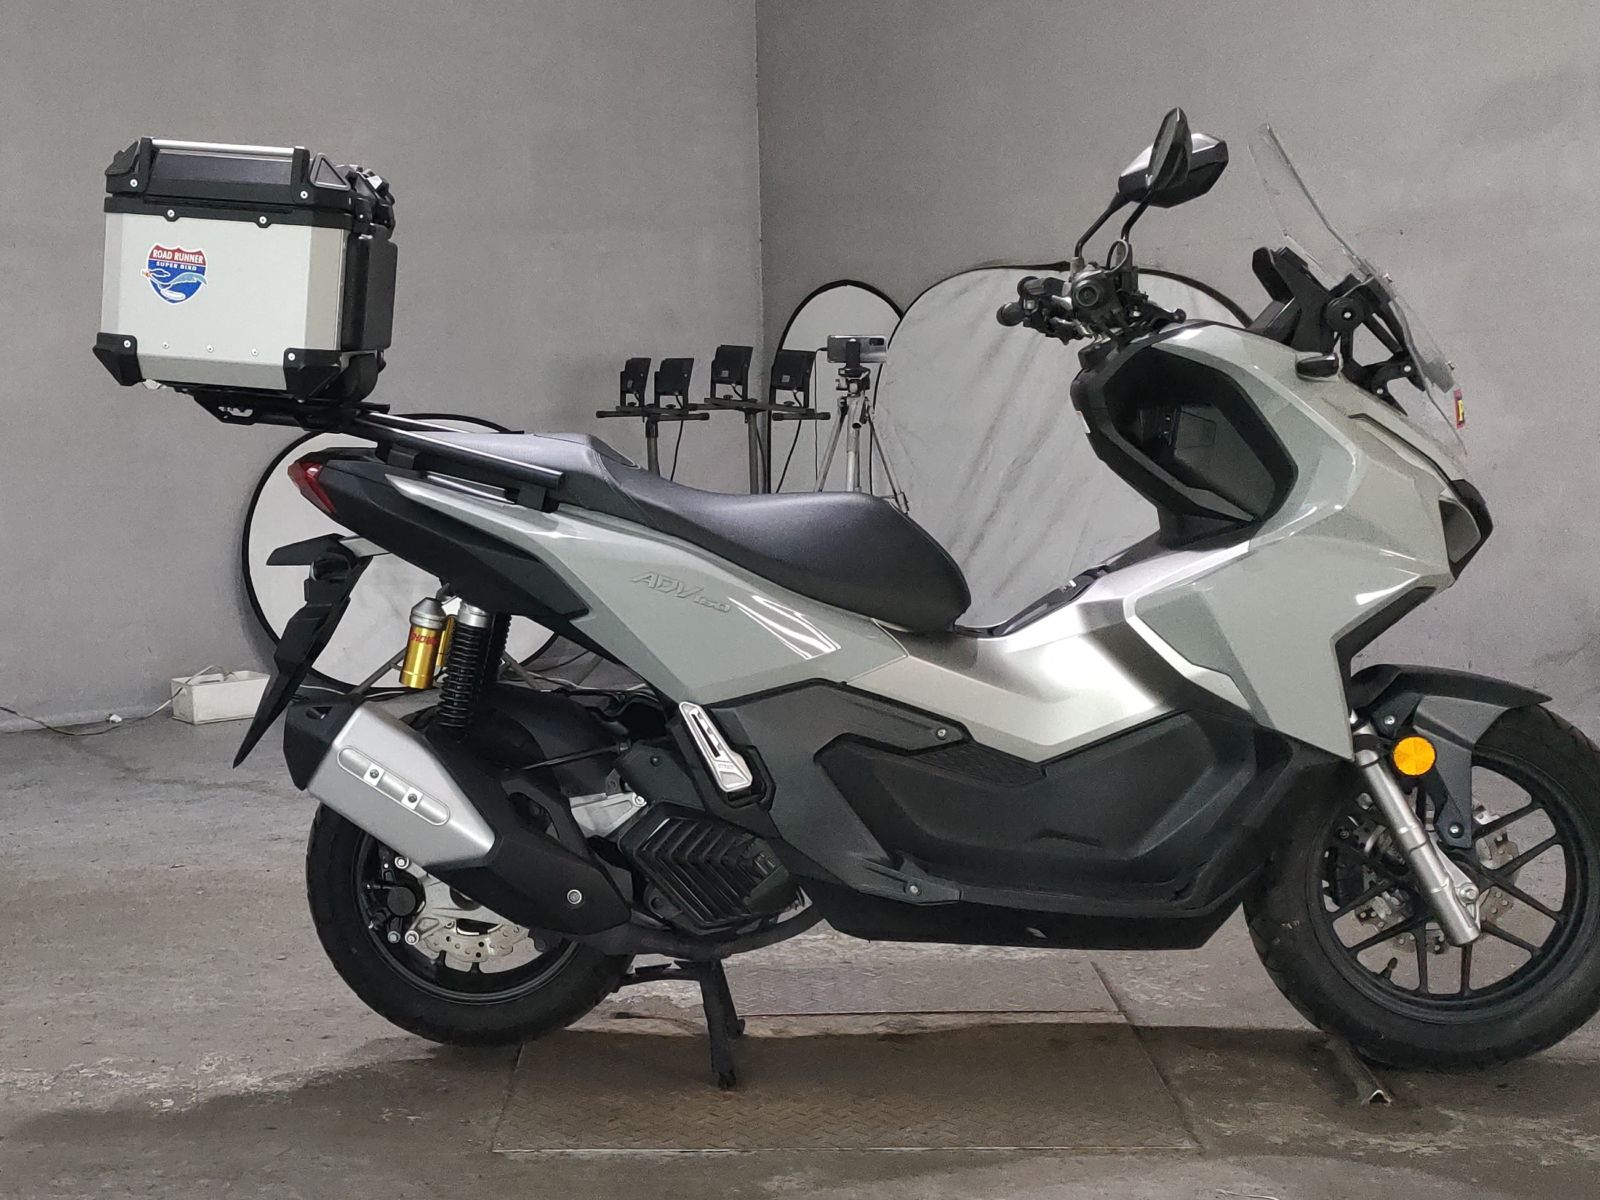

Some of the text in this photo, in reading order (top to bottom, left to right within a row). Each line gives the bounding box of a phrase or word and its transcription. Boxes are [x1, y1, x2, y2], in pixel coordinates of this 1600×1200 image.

[152, 249, 203, 263] ROAD RUNNER
[629, 572, 704, 599] ADV
